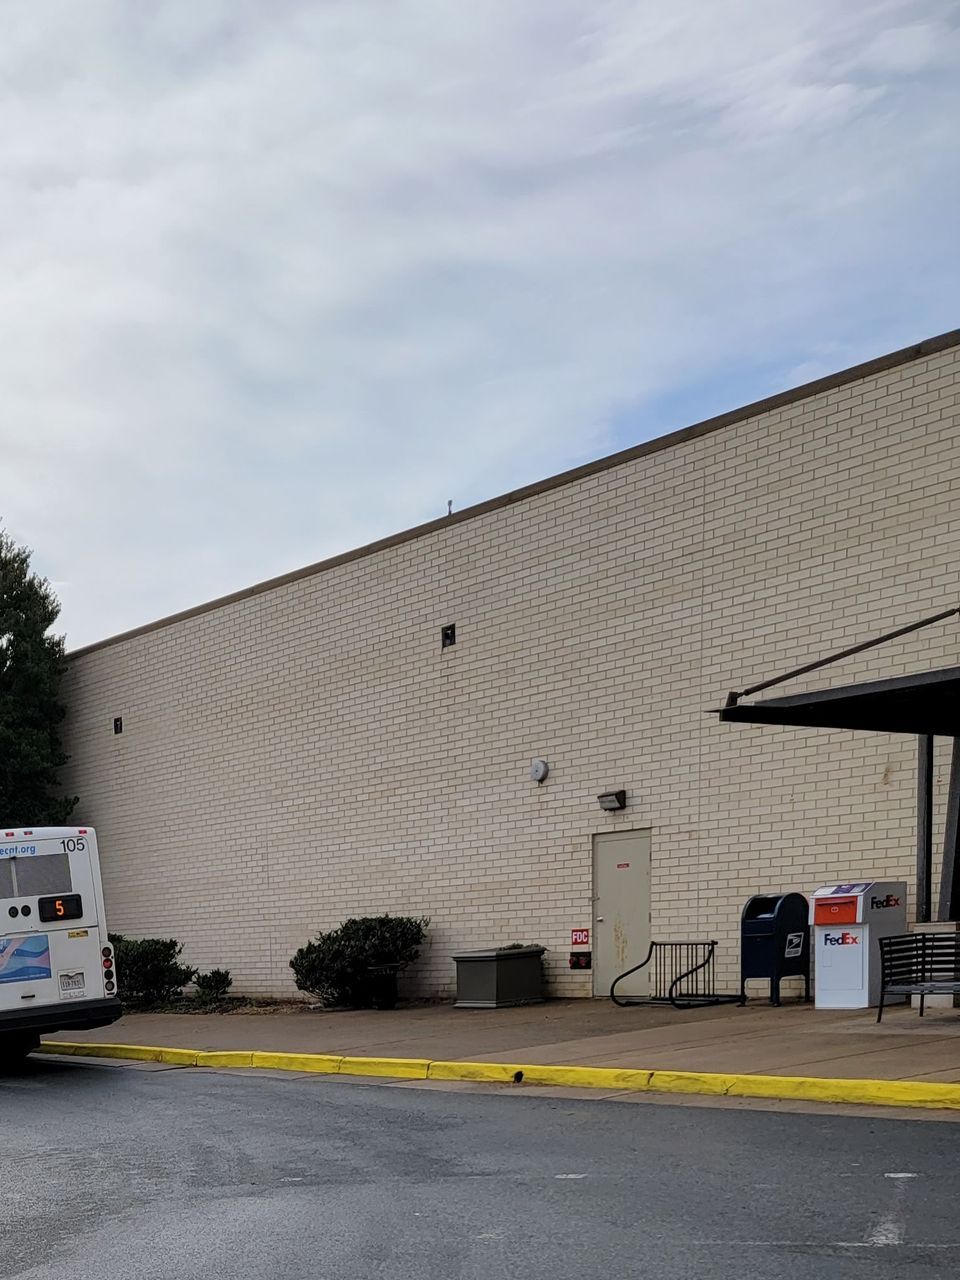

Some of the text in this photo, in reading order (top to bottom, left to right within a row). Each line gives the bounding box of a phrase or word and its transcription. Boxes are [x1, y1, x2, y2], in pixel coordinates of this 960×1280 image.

[59, 838, 85, 853] 105
[55, 900, 64, 916] 5
[871, 894, 900, 910] FedEx
[572, 930, 588, 943] FDC
[824, 932, 859, 946] FedEx
